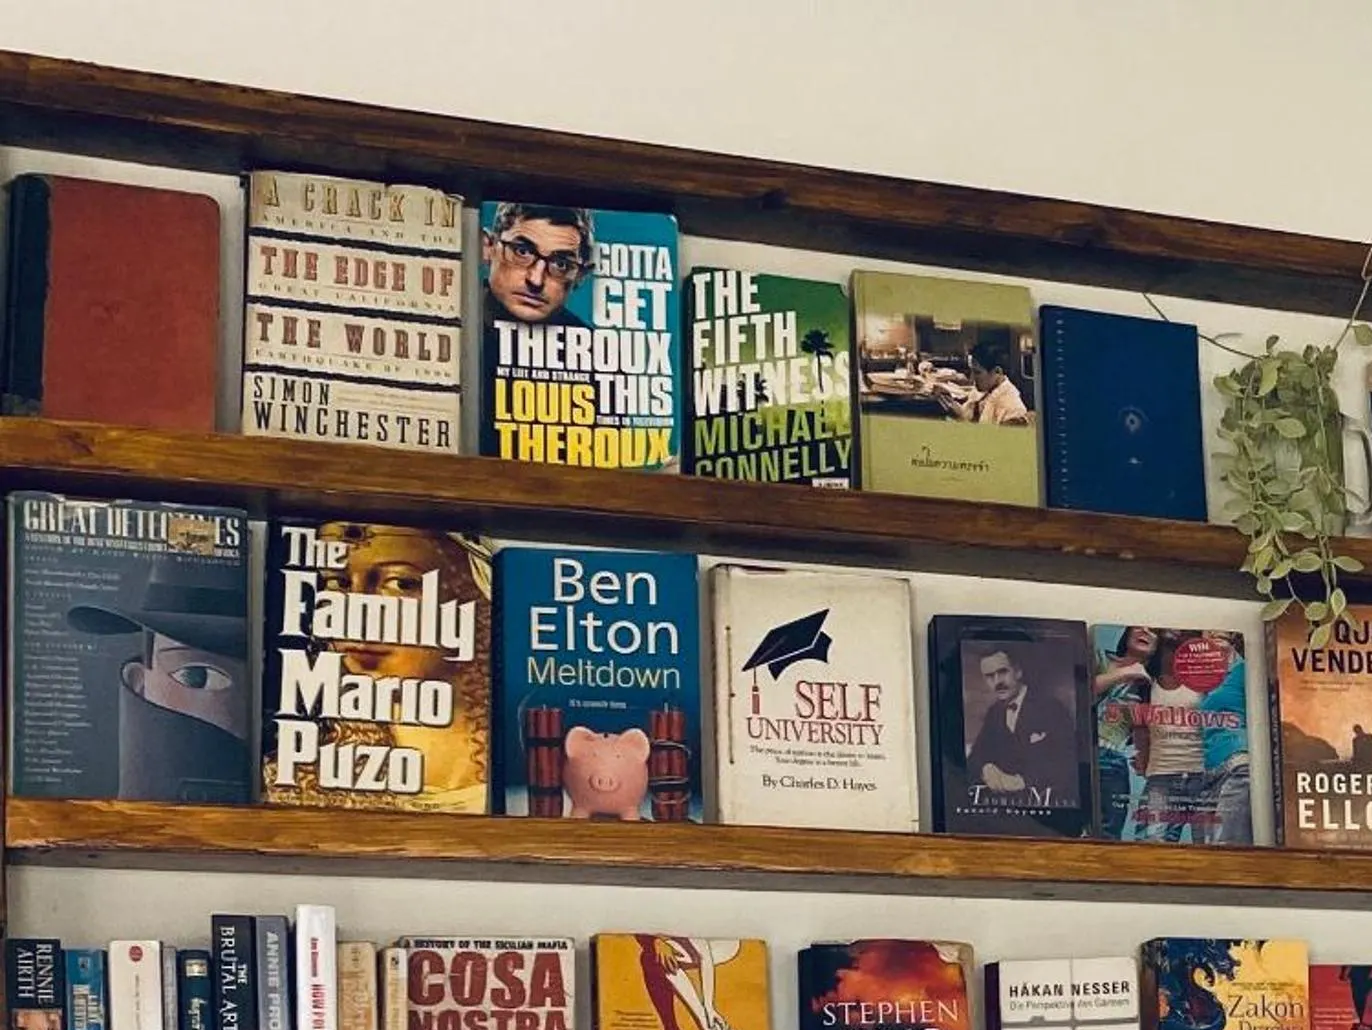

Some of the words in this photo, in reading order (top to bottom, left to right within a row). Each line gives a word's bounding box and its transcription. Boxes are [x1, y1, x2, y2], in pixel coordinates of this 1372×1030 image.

[264, 175, 280, 207] A
[304, 182, 405, 222] CRACK
[424, 196, 457, 228] IN
[260, 245, 318, 281] THE
[334, 255, 406, 292] EDGE
[422, 266, 454, 296] OF
[595, 244, 673, 281] GOTTA
[593, 279, 673, 330] GET
[693, 270, 761, 319] THE
[257, 312, 321, 348] THE
[344, 323, 451, 362] WORLD
[494, 320, 673, 376] THEROUX
[693, 311, 797, 369] FIFTH
[254, 375, 330, 405] SIMON
[495, 378, 595, 425] LOUIS
[595, 374, 672, 416] THIS
[694, 350, 850, 416] WITNESS
[254, 401, 450, 447] WINCHESTER
[494, 422, 672, 468] THEROUX
[695, 439, 851, 483] CONNELLY
[24, 500, 98, 535] GREAT
[281, 526, 348, 569] The
[553, 557, 657, 605] Ben
[279, 569, 477, 662] Family
[529, 605, 679, 654] Elton
[274, 648, 453, 727] Mario
[527, 656, 680, 689] Meltdown
[795, 680, 882, 721] SELF
[1131, 704, 1239, 729] Willows
[746, 716, 883, 746] UNIVERSITY
[274, 718, 425, 793] Puzo
[762, 774, 778, 788] By
[780, 776, 825, 789] Charles
[842, 778, 878, 791] Hayes
[219, 927, 238, 994] BRUTAL
[266, 931, 280, 988] ANNIE
[414, 940, 455, 948] HISTORY
[459, 940, 471, 948] OF
[474, 940, 491, 949] THE
[495, 940, 533, 949] SICILIAN
[537, 941, 568, 949] MAFIA
[16, 948, 35, 997] AIRTH
[35, 944, 55, 1004] RENNIE
[237, 963, 248, 984] THE
[407, 949, 568, 1008] COSA
[1009, 980, 1063, 998] HÅKAN
[1070, 981, 1130, 996] NESSER
[311, 984, 327, 1010] HOW
[821, 999, 958, 1026] STEPHEN
[1228, 994, 1304, 1024] Zakon
